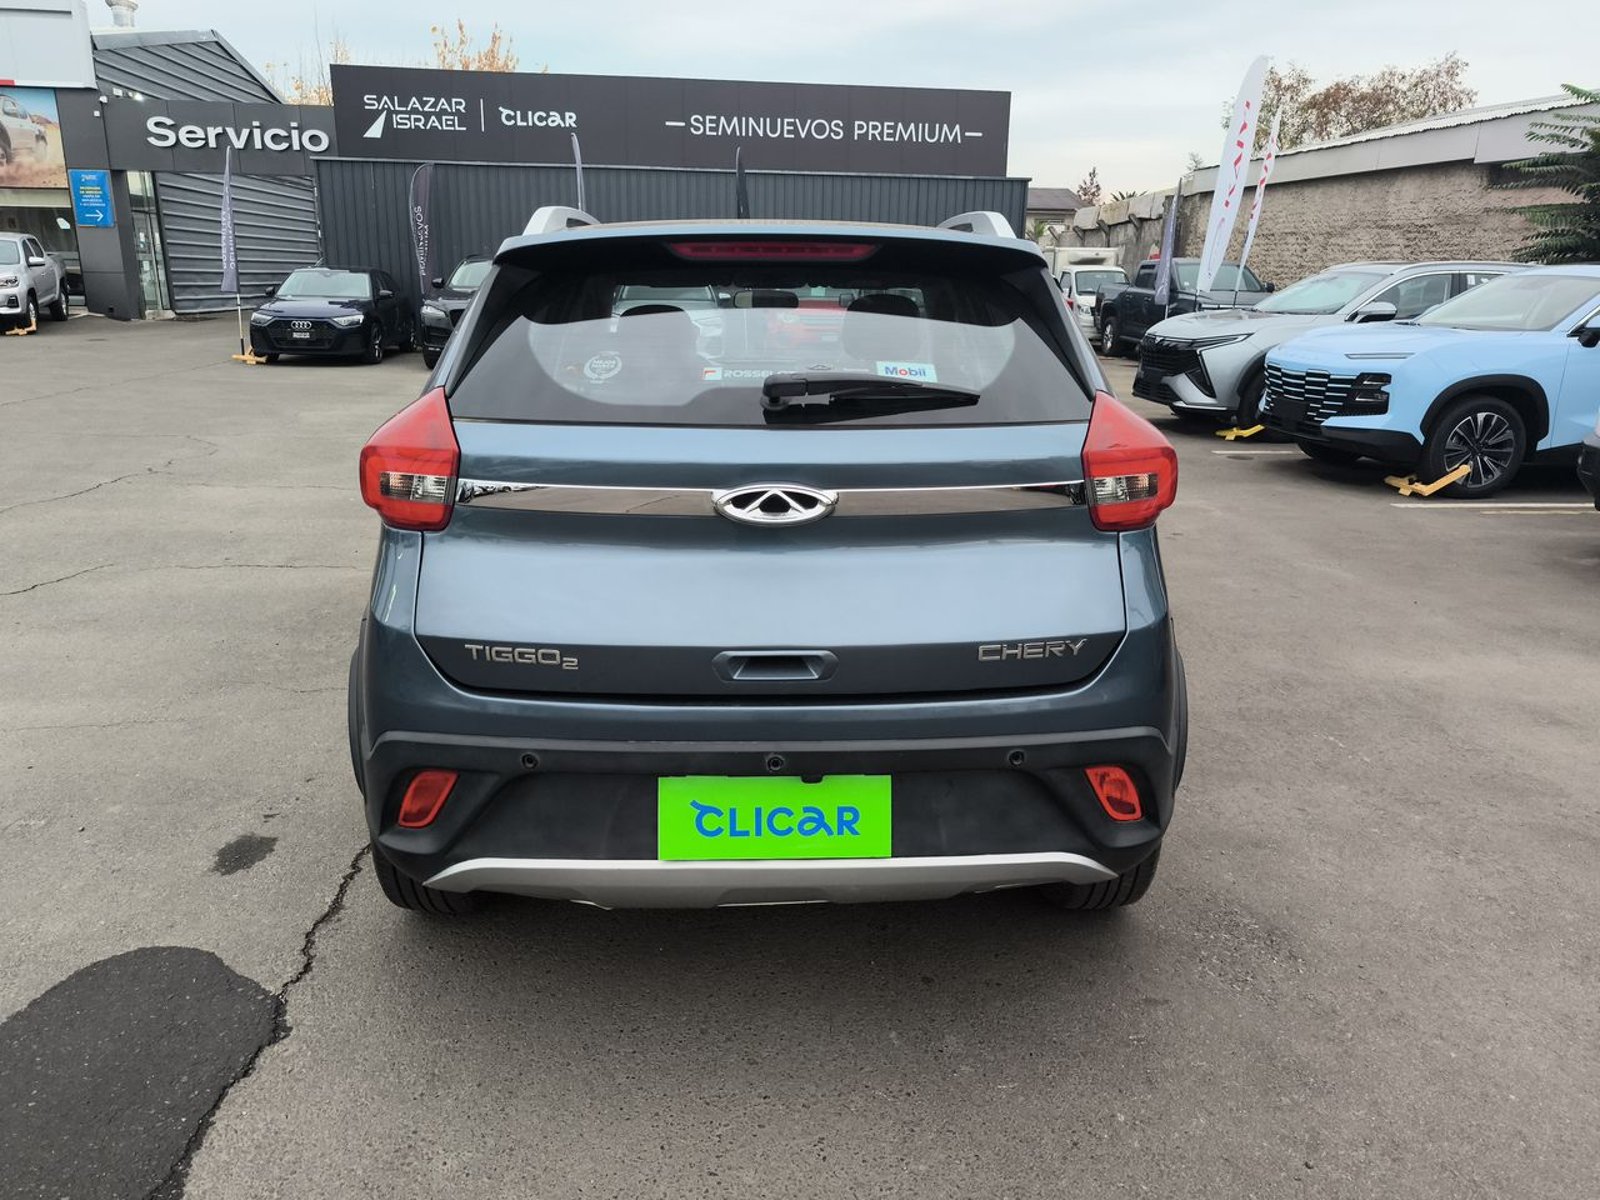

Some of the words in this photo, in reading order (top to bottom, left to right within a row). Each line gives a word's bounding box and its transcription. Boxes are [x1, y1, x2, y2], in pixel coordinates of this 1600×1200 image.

[363, 94, 466, 113] SALAZAR
[392, 113, 467, 131] ISRAEL
[690, 114, 844, 140] SEMINUEVOS
[853, 120, 962, 144] PREMIUM
[146, 116, 330, 152] Servicio
[884, 366, 926, 377] Mobil
[978, 638, 1088, 661] CHERY
